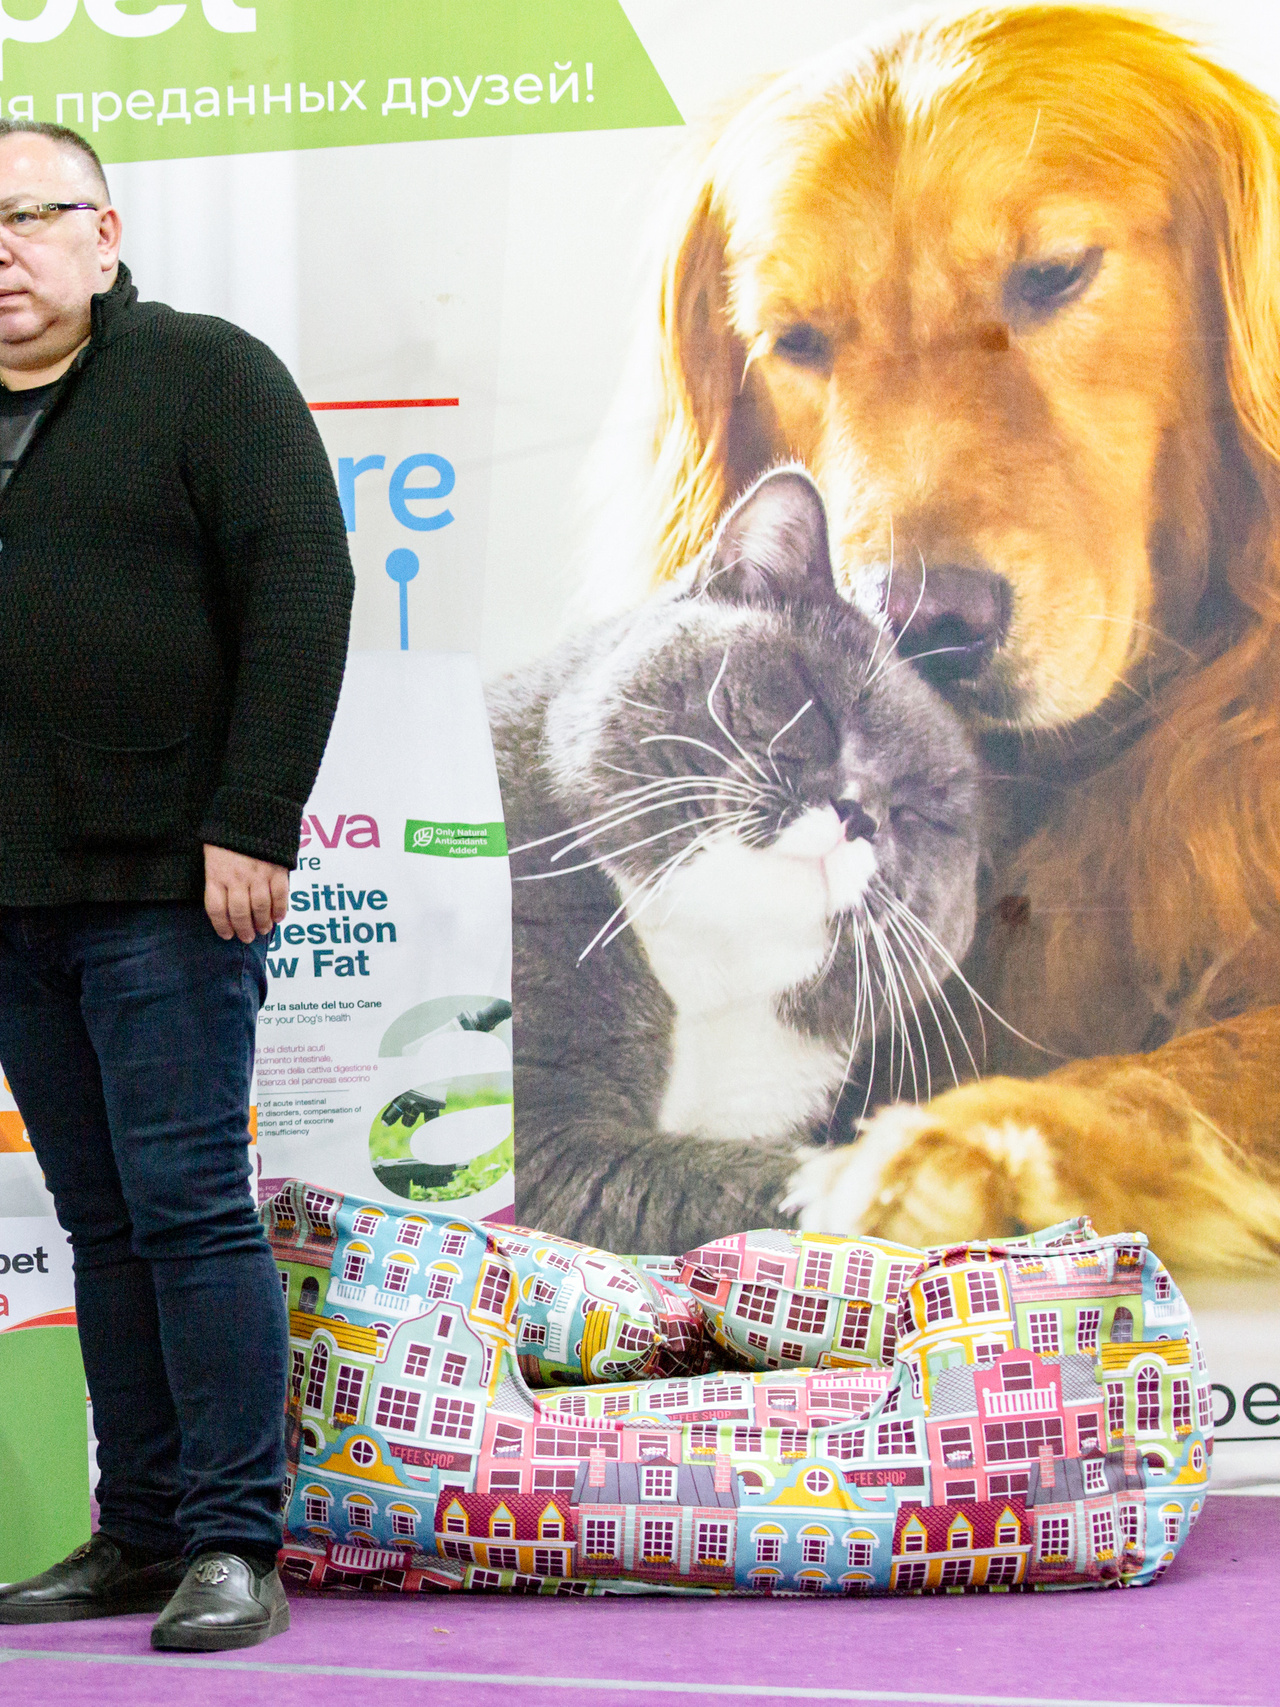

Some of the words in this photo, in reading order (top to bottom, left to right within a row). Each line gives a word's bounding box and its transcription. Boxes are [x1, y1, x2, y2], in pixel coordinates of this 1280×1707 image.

[56, 78, 368, 133] преданных
[381, 61, 594, 118] друзей!
[435, 828, 455, 838] Only
[457, 828, 487, 837] Natural
[435, 837, 487, 846] Antioxidants
[449, 846, 477, 854] Added
[287, 883, 388, 912] sitive
[313, 949, 370, 978] Fat
[289, 1002, 319, 1010] salute
[321, 1001, 336, 1009] del
[339, 1001, 355, 1009] tuo
[357, 1000, 382, 1008] Cane
[258, 1016, 273, 1024] For
[275, 1016, 294, 1026] your
[297, 1015, 323, 1025] Dog's
[325, 1014, 351, 1022] health
[277, 1045, 305, 1053] disturbi
[307, 1044, 325, 1052] acuti
[287, 1067, 305, 1075] della
[333, 1064, 371, 1074] digestione
[302, 1077, 336, 1086] pancreas
[338, 1075, 370, 1083] esocrino
[295, 1098, 326, 1106] intestinal
[265, 1109, 301, 1118] disorders,
[303, 1107, 353, 1116] compensation
[265, 1128, 310, 1137] insufficiency
[702, 1410, 732, 1420] SHOP
[424, 1451, 455, 1468] SHOP
[877, 1471, 906, 1485] SHOP
